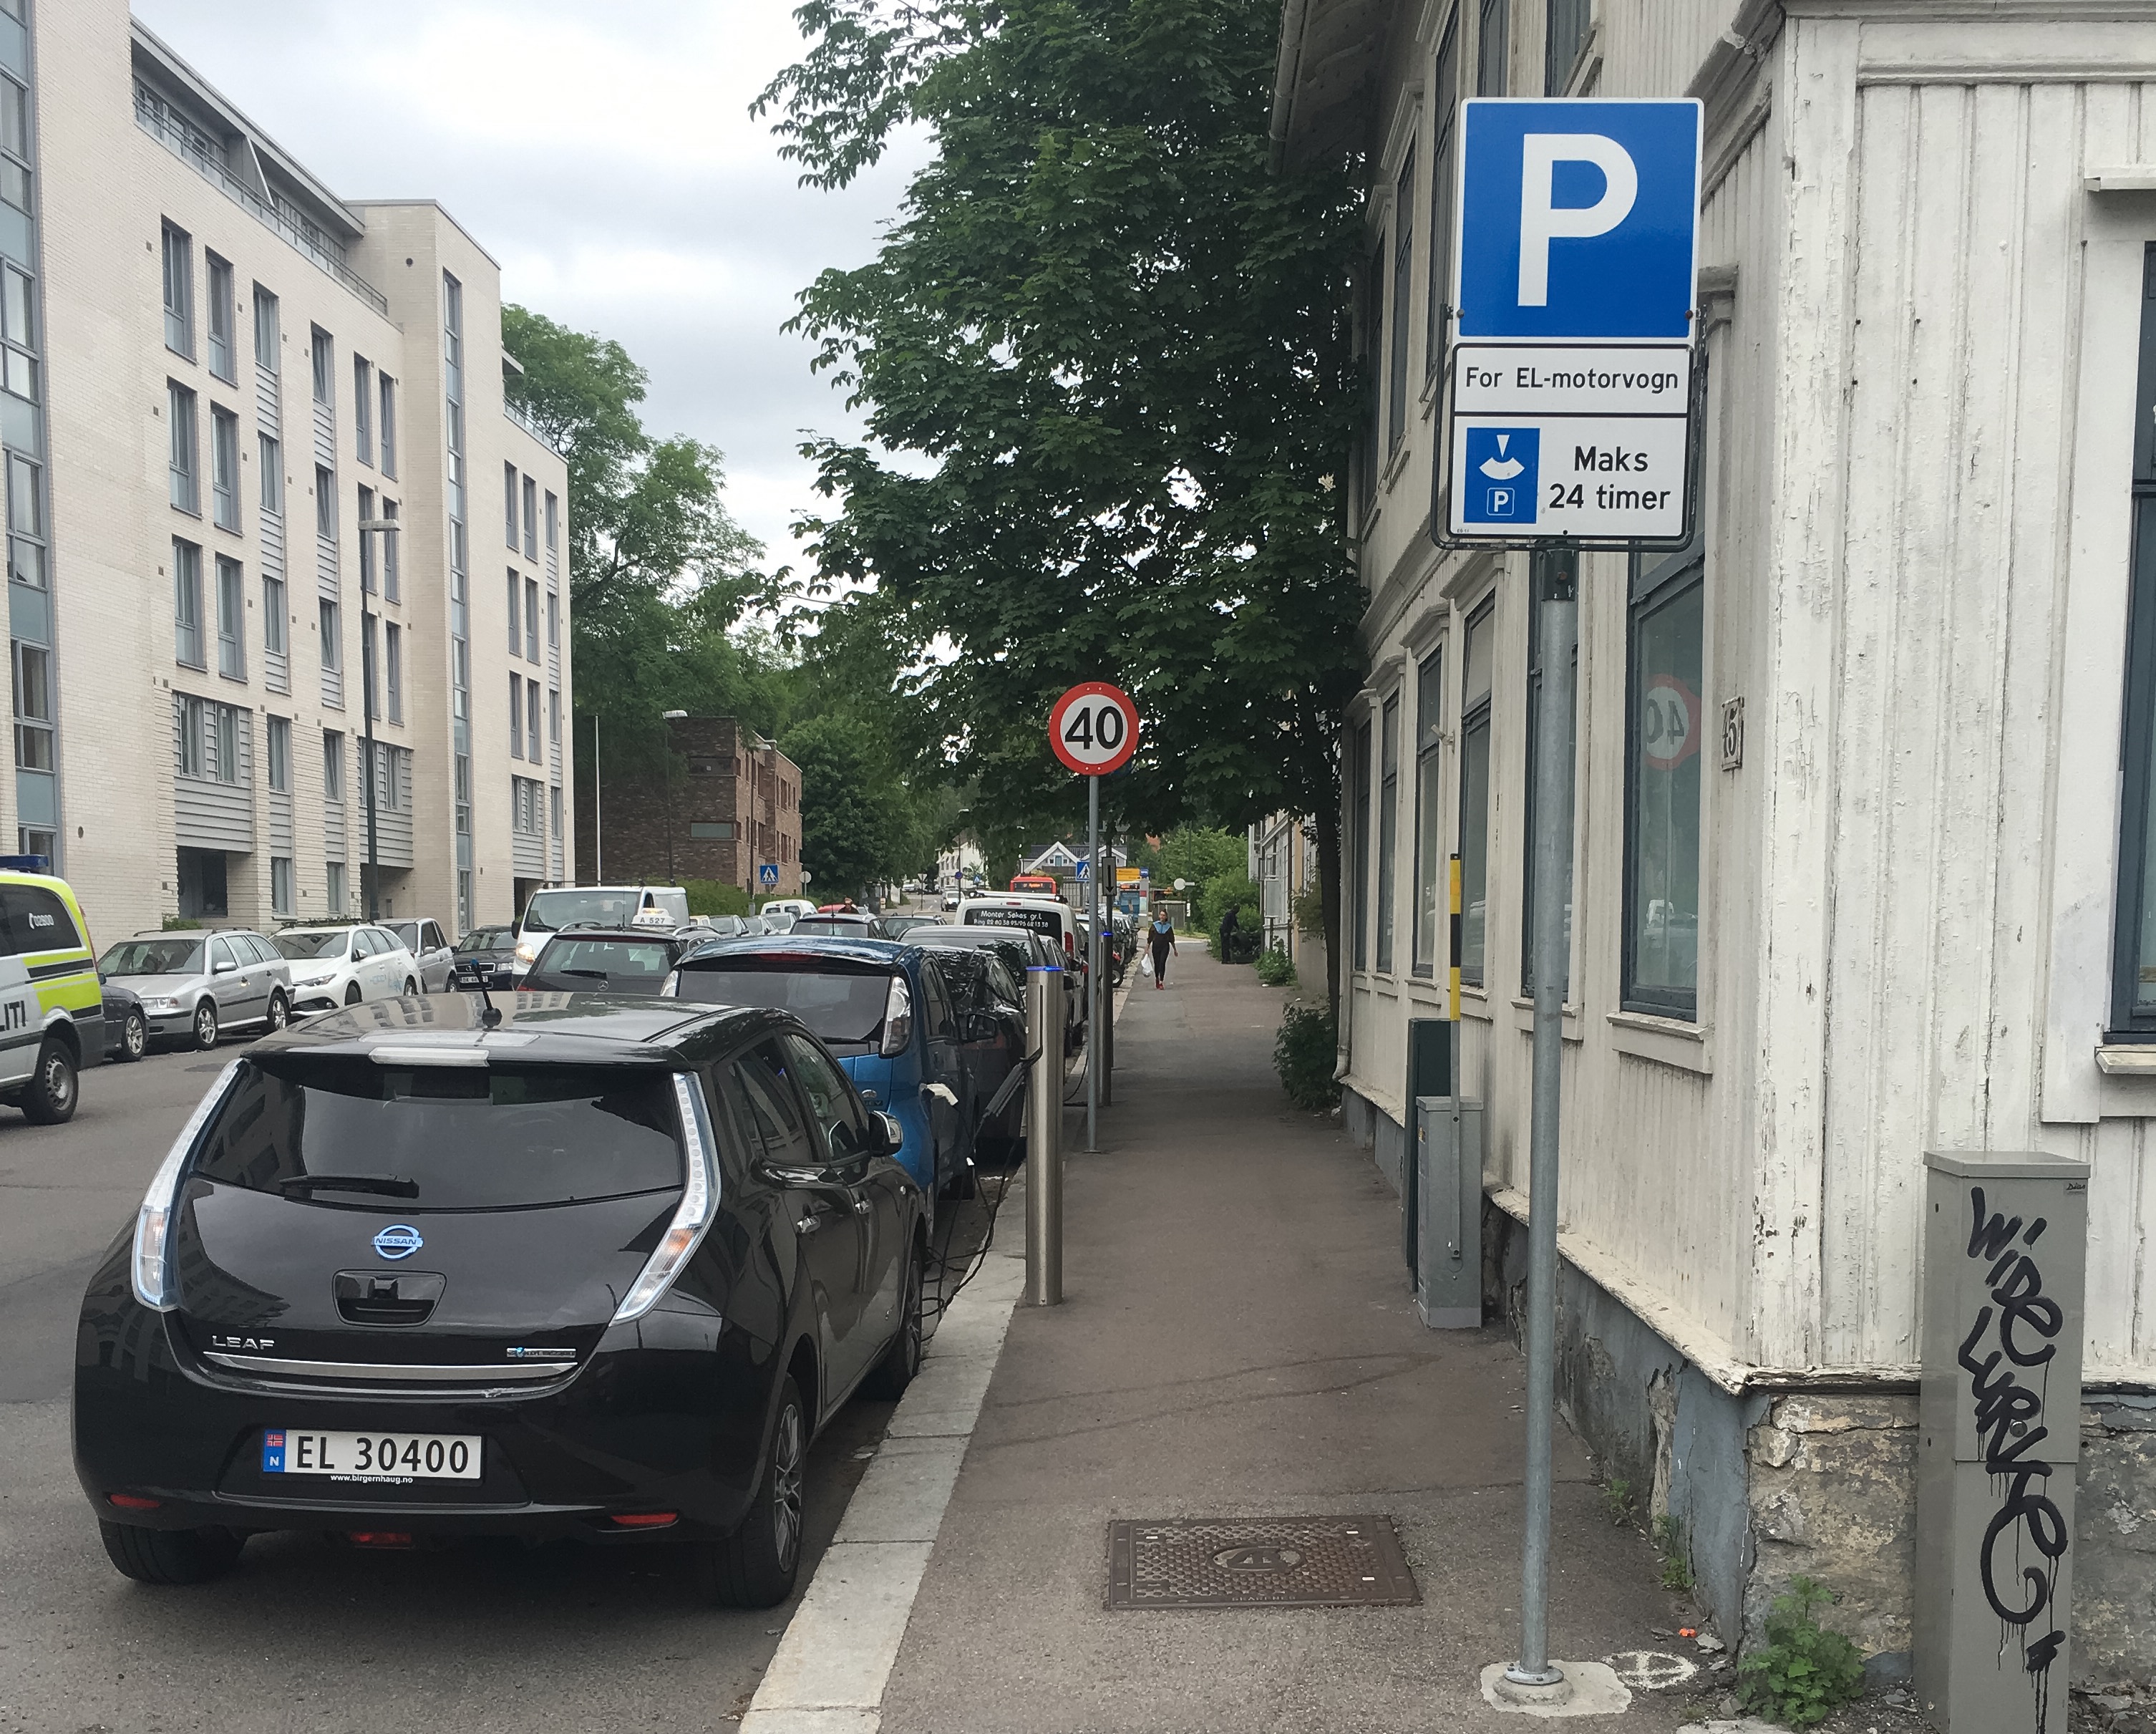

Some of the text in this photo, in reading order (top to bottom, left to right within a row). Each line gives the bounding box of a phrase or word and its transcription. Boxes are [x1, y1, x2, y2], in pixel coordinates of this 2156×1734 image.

[1518, 133, 1638, 306] P
[1466, 367, 1679, 394] For EL-motorvogn
[1574, 445, 1649, 473] Maks
[1493, 491, 1509, 513] P
[1549, 483, 1671, 510] 24 timer
[1064, 705, 1124, 750] 40
[212, 1335, 275, 1350] LEAF
[269, 1456, 279, 1466] N
[296, 1435, 469, 1473] EL 30400
